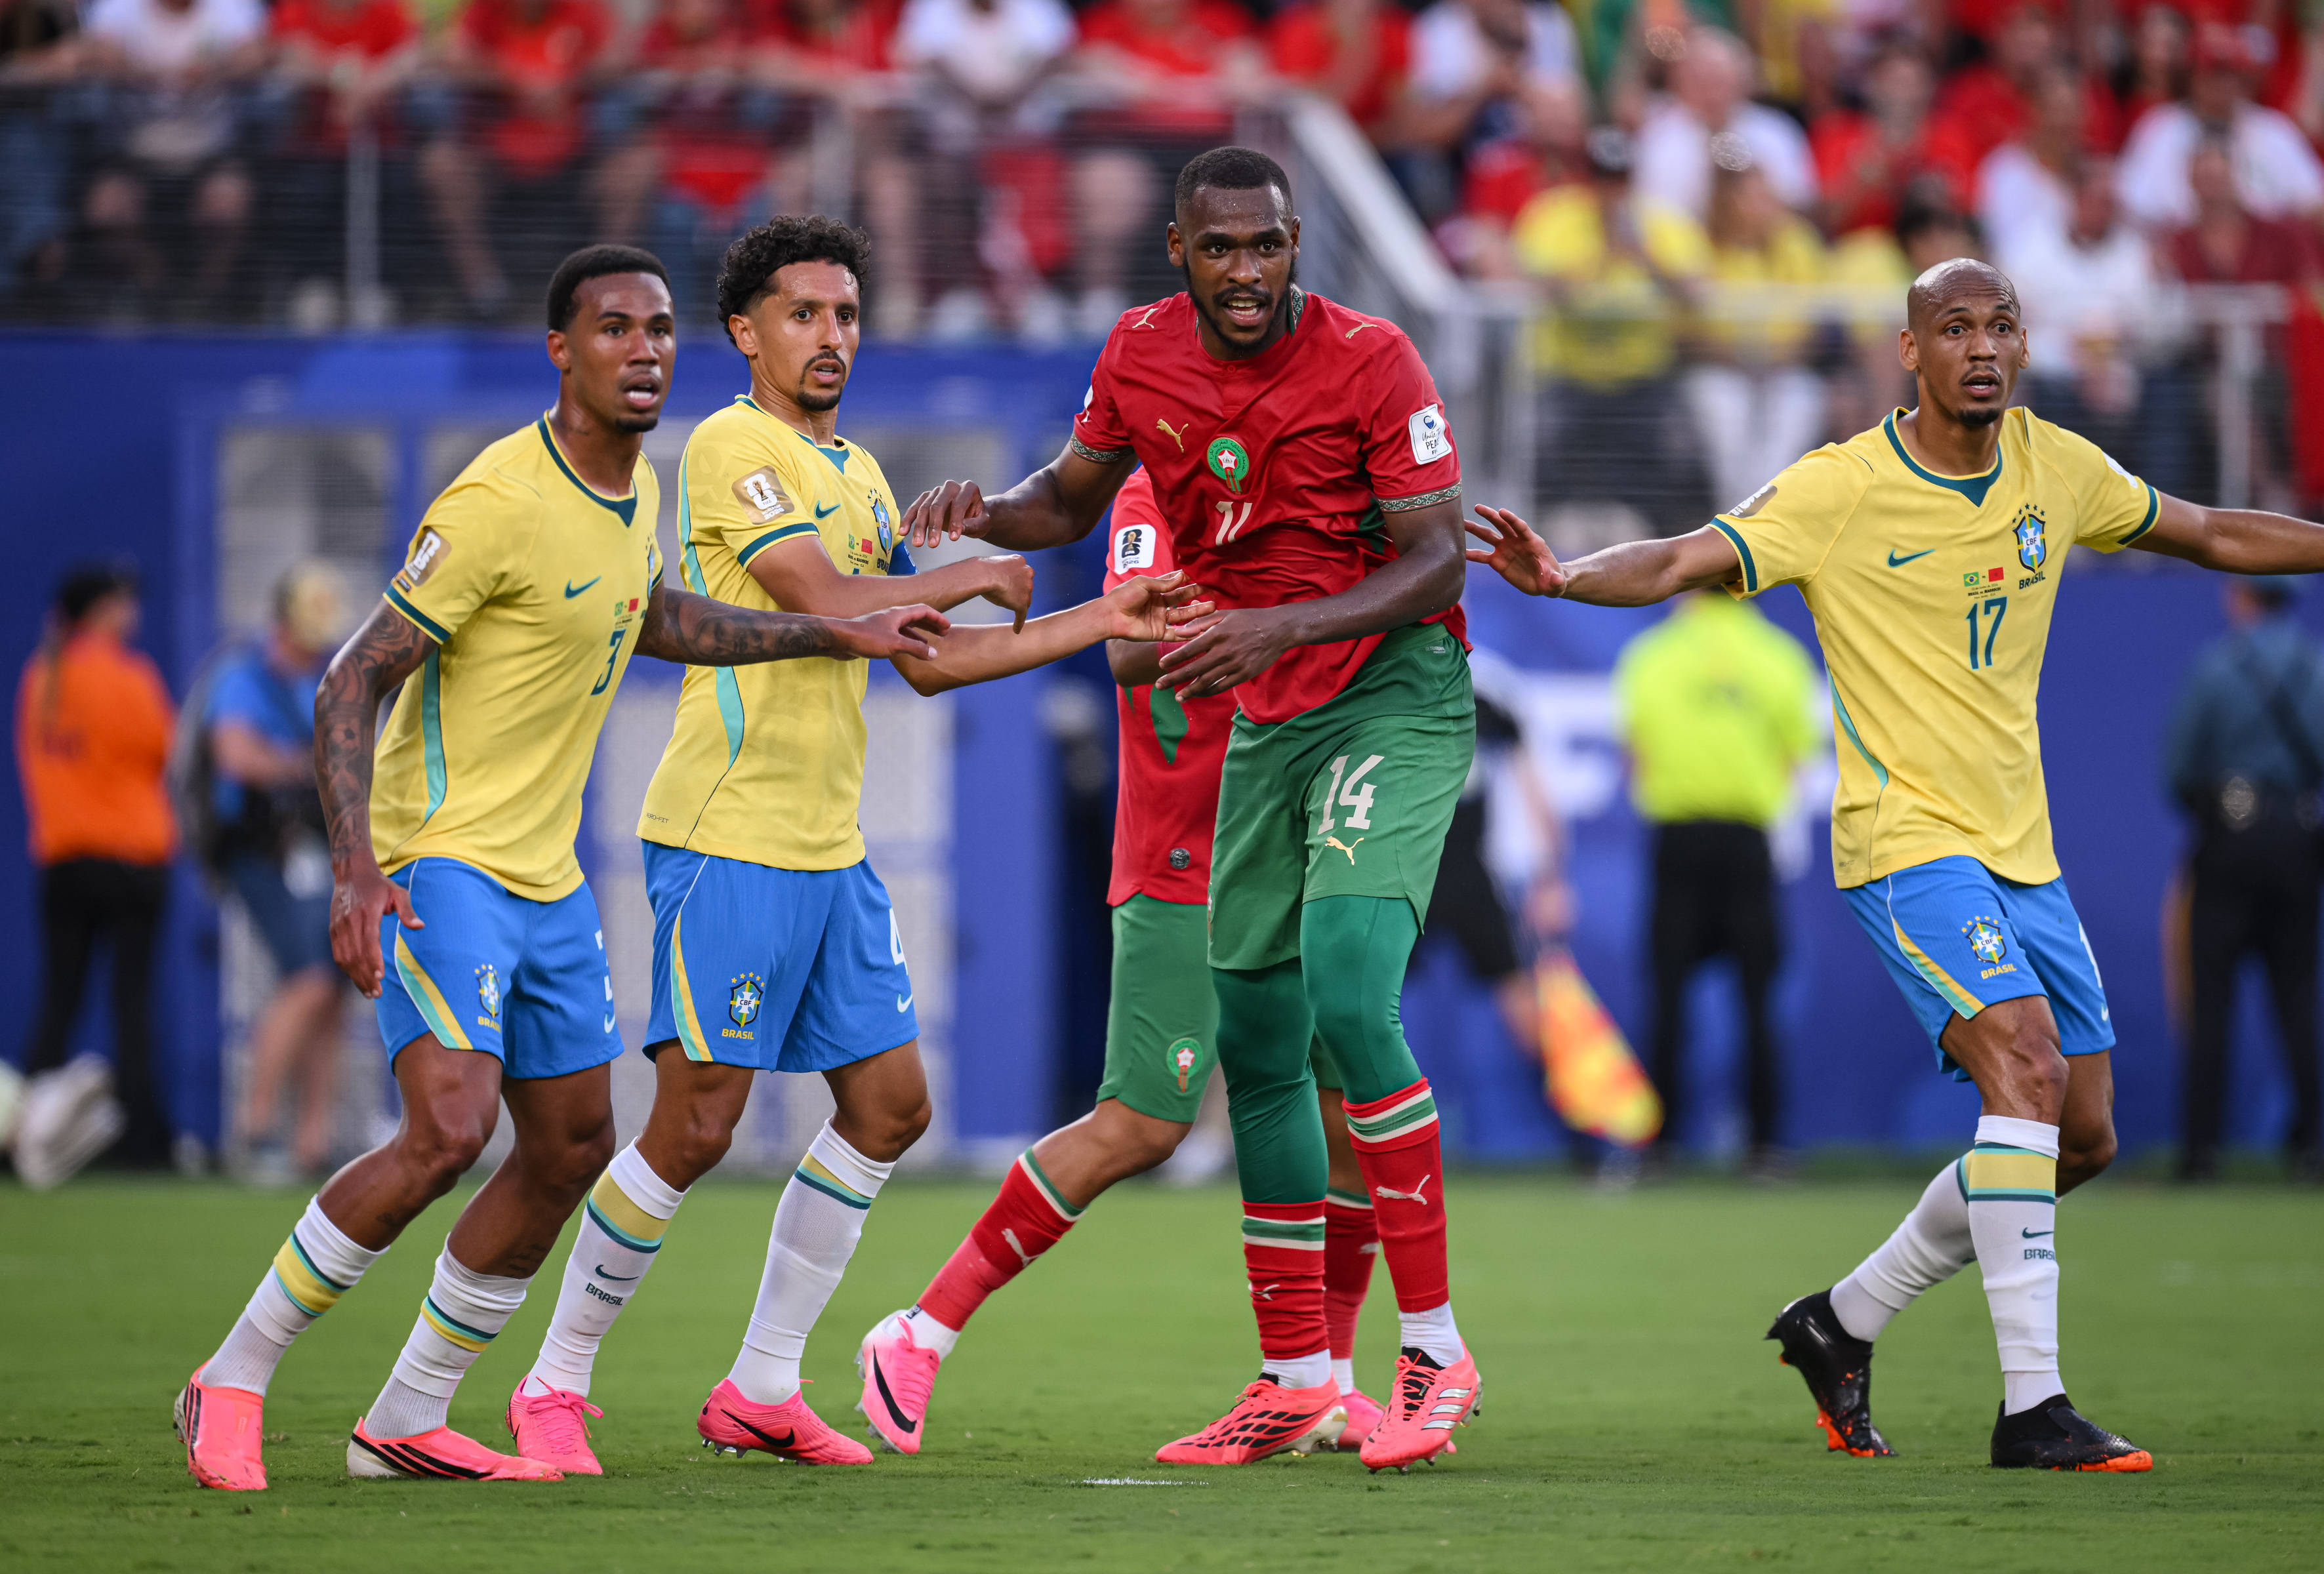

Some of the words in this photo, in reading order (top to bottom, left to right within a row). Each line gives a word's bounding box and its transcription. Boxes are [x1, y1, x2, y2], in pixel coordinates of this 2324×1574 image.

[2026, 536, 2037, 546] CBF
[2019, 571, 2046, 590] BRASIL
[1965, 596, 2007, 670] 17
[590, 628, 626, 696] 3
[1317, 754, 1385, 836] 14
[1981, 963, 2017, 980] BRASIL
[722, 1028, 754, 1039] BRASIL
[585, 1282, 623, 1306] BRASIL
